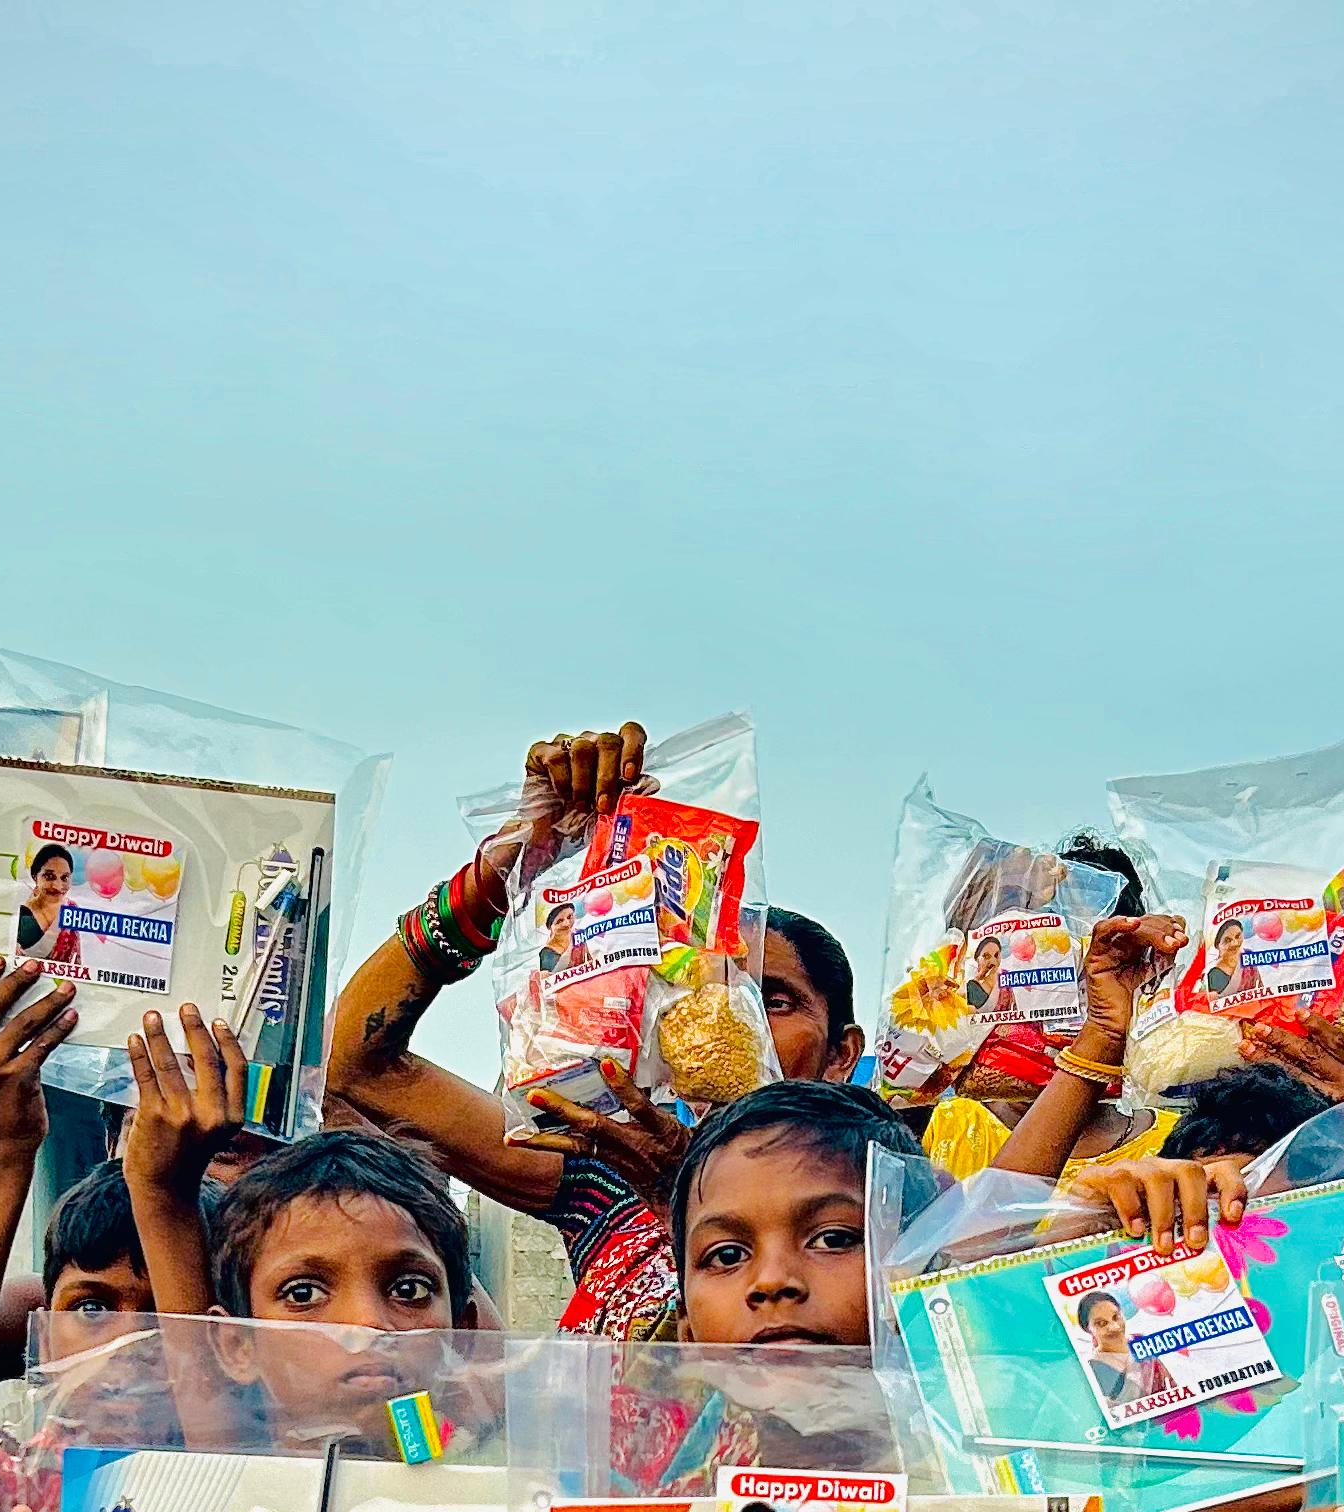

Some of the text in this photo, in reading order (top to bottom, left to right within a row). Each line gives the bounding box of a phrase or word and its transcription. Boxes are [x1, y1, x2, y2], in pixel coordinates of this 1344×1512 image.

[39, 822, 165, 855] Happy Diwali
[612, 824, 627, 859] FREE
[549, 865, 638, 902] Happy Diwali
[63, 909, 168, 941] BHAGYA REKHA
[574, 909, 652, 945] BHAGYA REKHA
[1216, 900, 1308, 923] Happy Diwali
[554, 947, 659, 984] AARSHA FOUNDATION
[1242, 942, 1326, 966] BHAGYA REKHA
[38, 962, 166, 991] ARSHA FOUNDATION
[1000, 968, 1072, 987] BHAGYA REKHA
[1223, 979, 1333, 1007] AARSHA FOUNDATION
[980, 1006, 1078, 1023] AARSHA FOUNDATION
[1066, 1263, 1131, 1293] Happy
[1133, 1311, 1248, 1361] BHAGYA REKHA
[1123, 1360, 1274, 1419] AARSHA FOUNDATION
[739, 1476, 886, 1502] Happy Diwali
